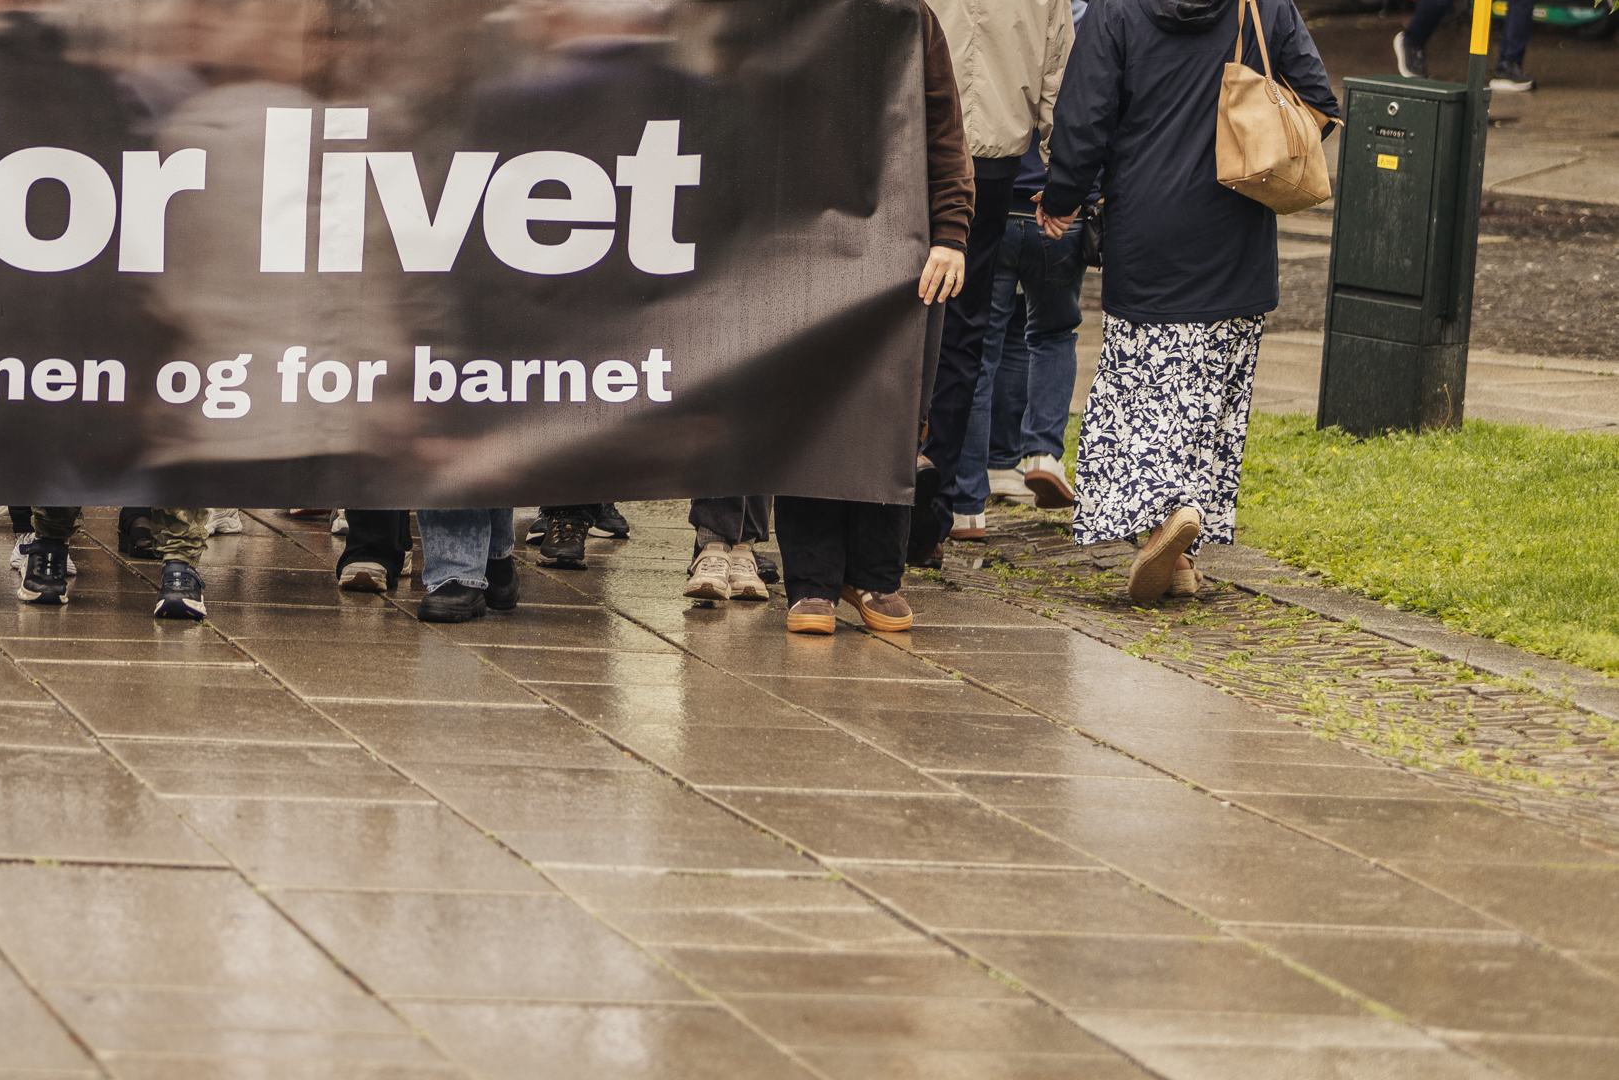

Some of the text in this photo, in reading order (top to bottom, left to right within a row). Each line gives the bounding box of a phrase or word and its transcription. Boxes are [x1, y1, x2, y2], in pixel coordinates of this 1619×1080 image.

[259, 107, 702, 275] livet
[155, 352, 252, 419] og
[277, 346, 387, 404] for
[413, 346, 674, 404] barnet
